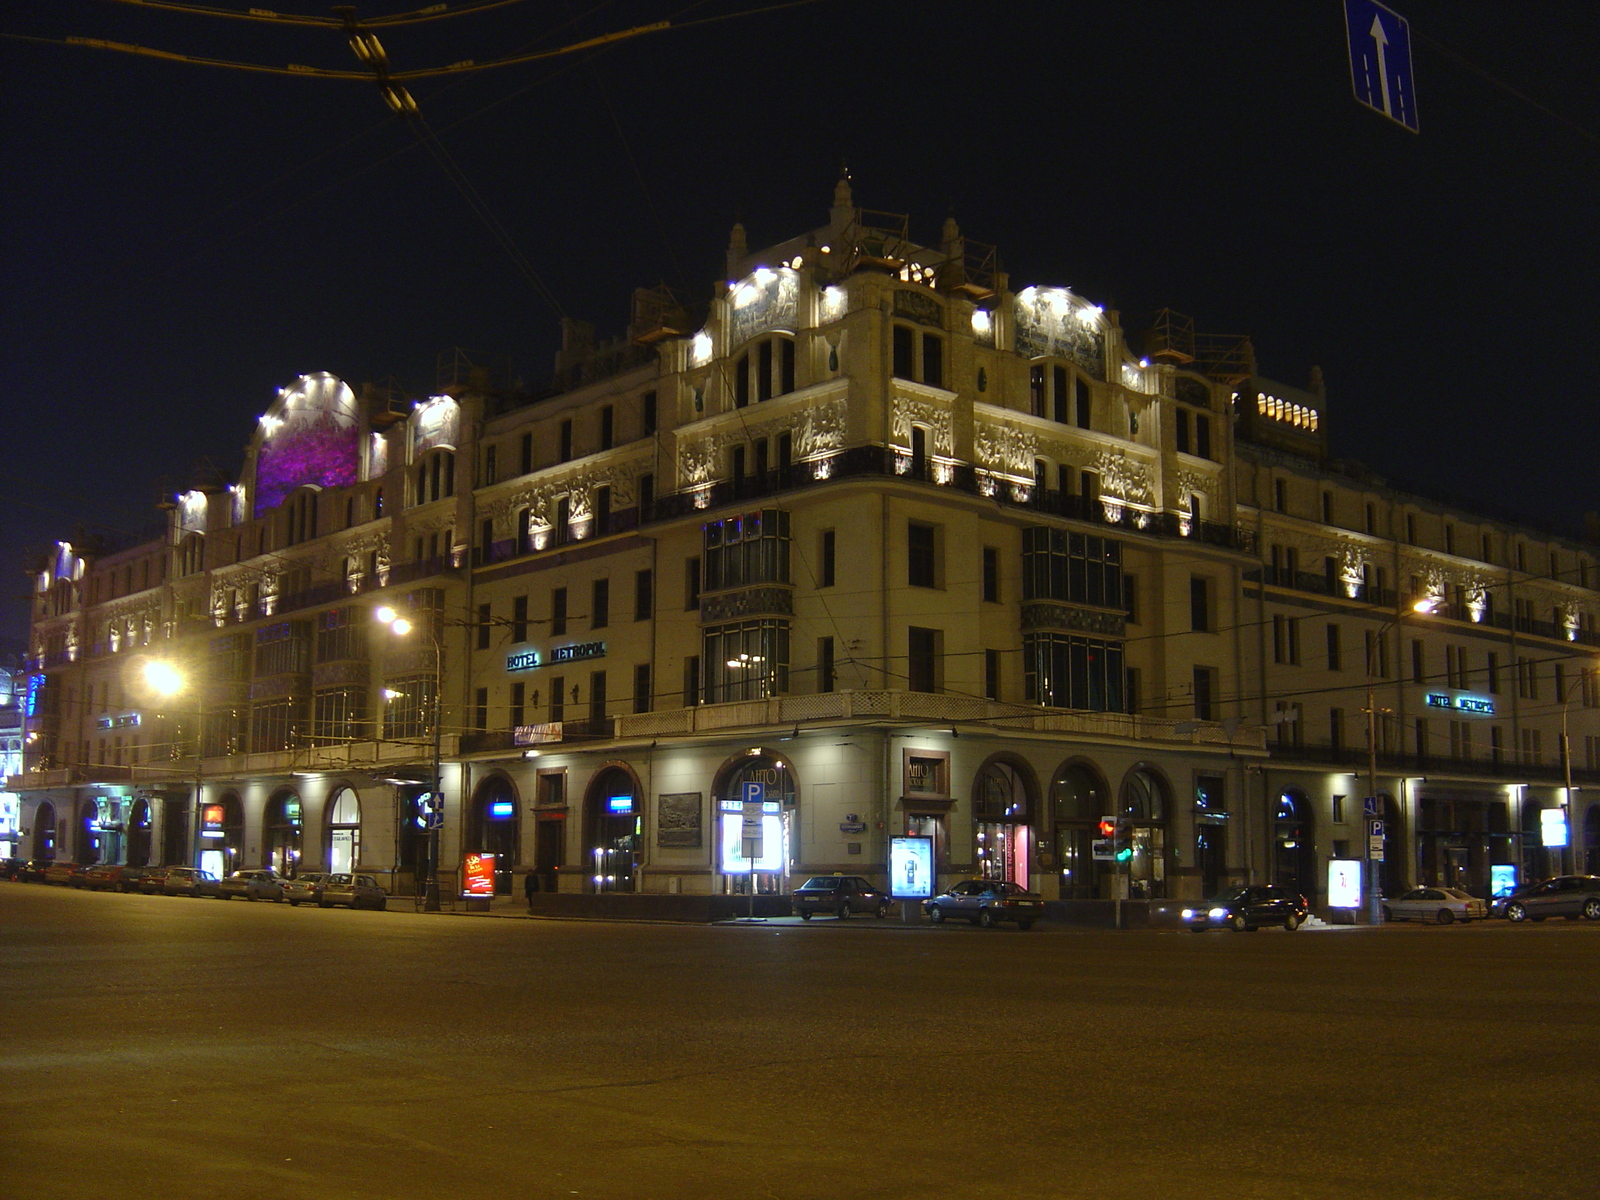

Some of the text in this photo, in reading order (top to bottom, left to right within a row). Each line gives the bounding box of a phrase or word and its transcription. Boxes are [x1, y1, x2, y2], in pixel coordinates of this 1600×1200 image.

[507, 642, 605, 668] HOTEL METROPOL
[748, 784, 760, 802] P
[1373, 821, 1382, 835] P
